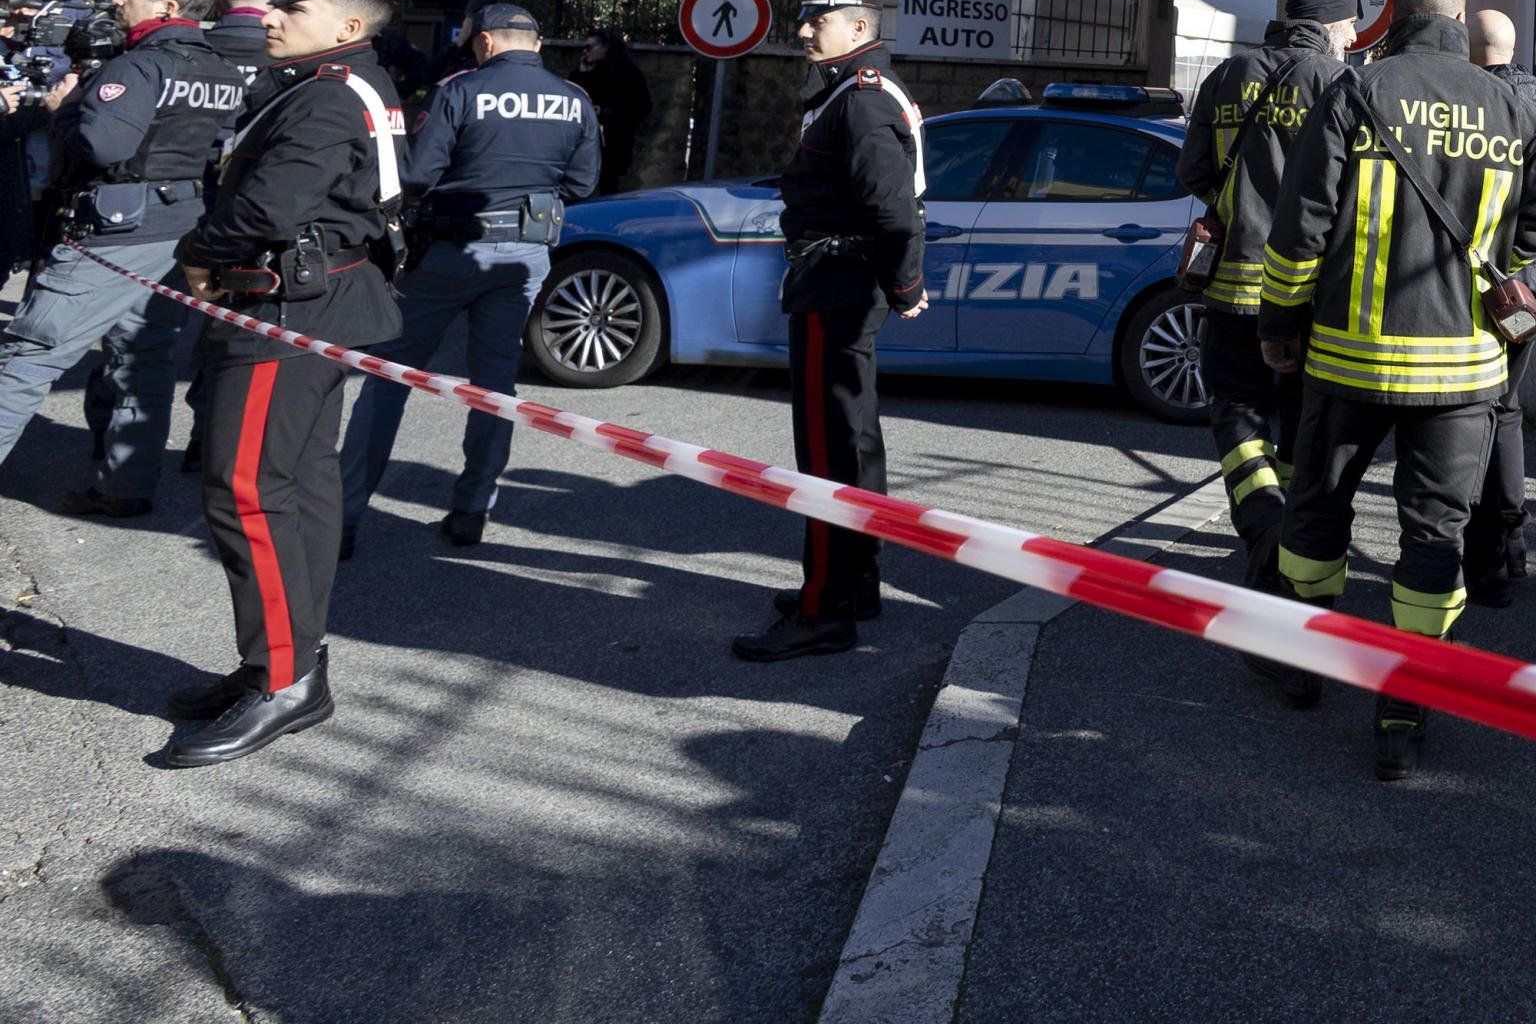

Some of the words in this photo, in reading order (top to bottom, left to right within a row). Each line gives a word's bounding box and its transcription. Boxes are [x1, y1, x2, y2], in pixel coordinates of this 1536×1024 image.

[919, 26, 995, 49] AUTO
[169, 80, 243, 111] POLIZIA
[476, 92, 582, 124] POLIZIA
[1240, 81, 1299, 105] VIILI
[1254, 105, 1310, 127] FUOC
[1400, 99, 1485, 131] VIGILI
[1426, 129, 1524, 166] FUOCO
[928, 262, 1100, 300] IZIA
